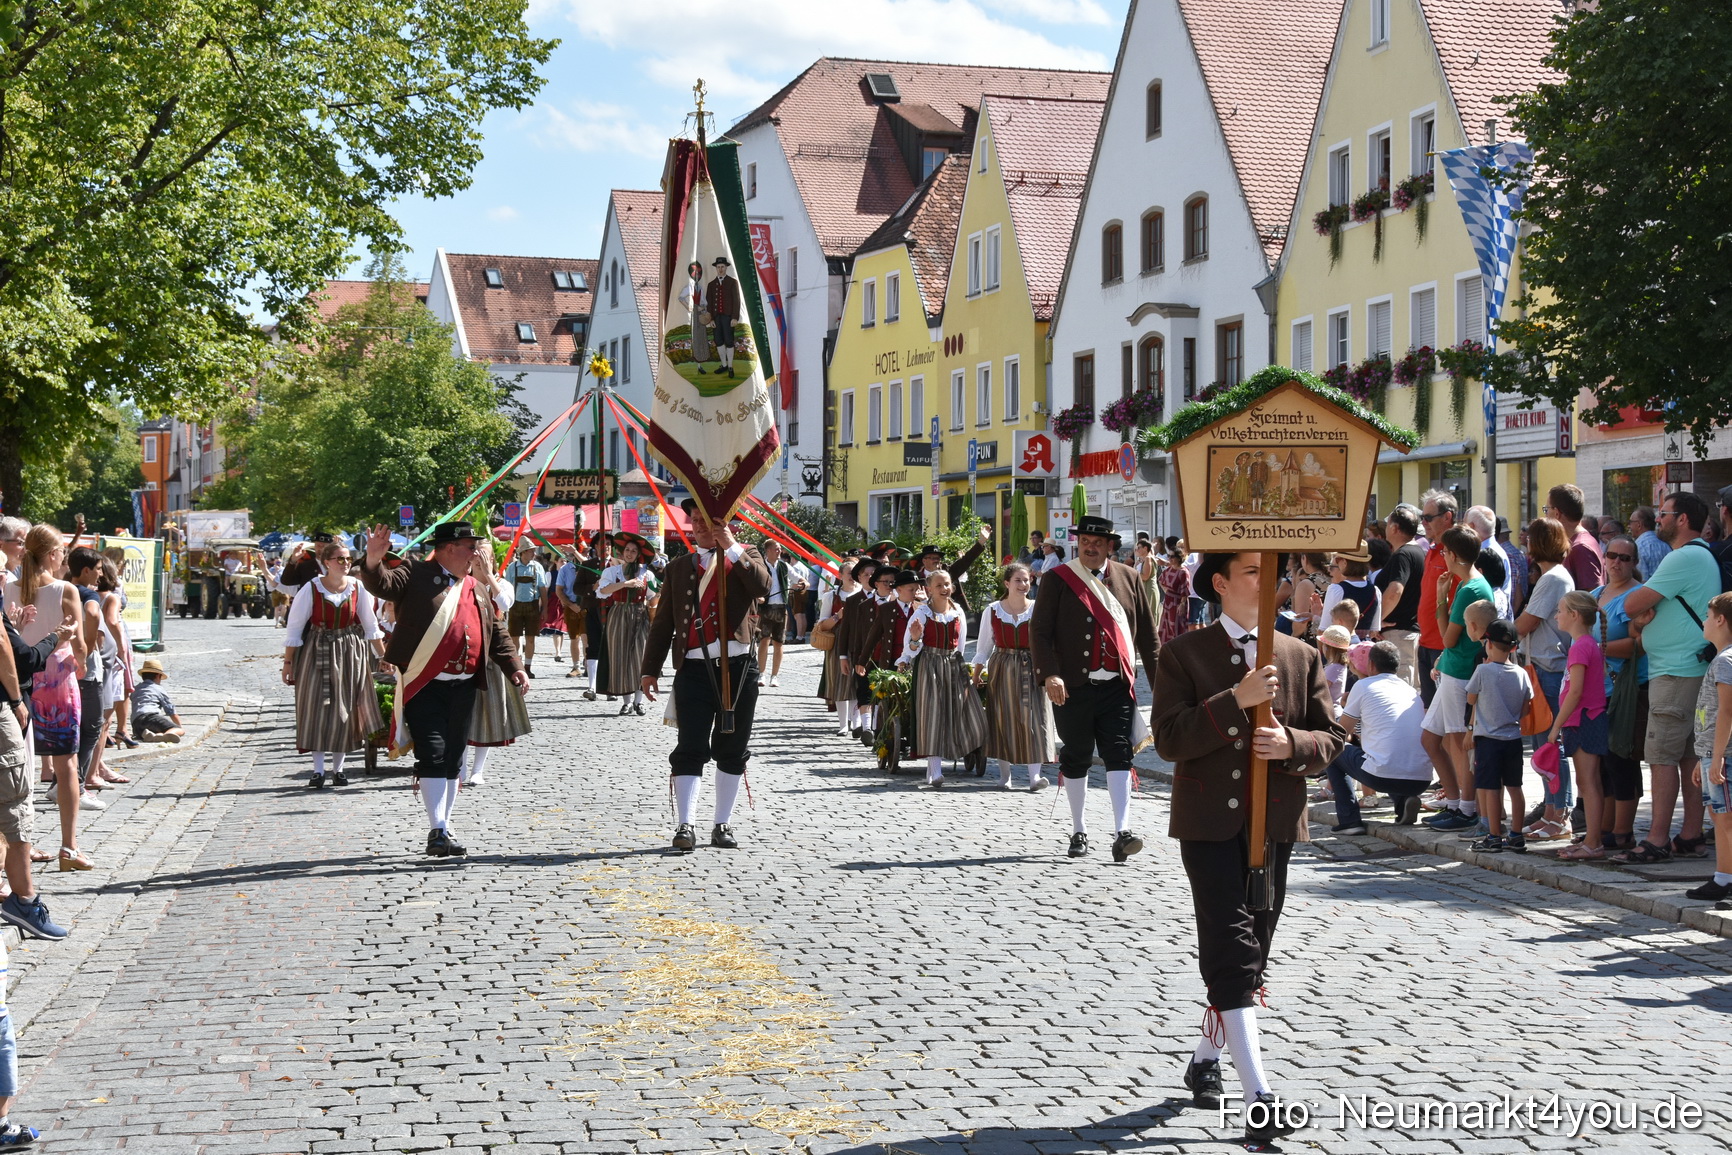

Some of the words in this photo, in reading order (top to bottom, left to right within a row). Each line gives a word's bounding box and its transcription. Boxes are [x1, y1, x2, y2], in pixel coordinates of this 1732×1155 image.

[875, 351, 900, 376] HOTEL
[906, 346, 935, 368] Lehmeier
[1248, 405, 1304, 429] Heimat
[1505, 413, 1528, 429] RIALTO
[1530, 410, 1546, 426] KINO
[1210, 426, 1349, 444] Volkstrachtenverein
[872, 468, 908, 485] Restaurant
[1228, 521, 1317, 544] Sindlbach
